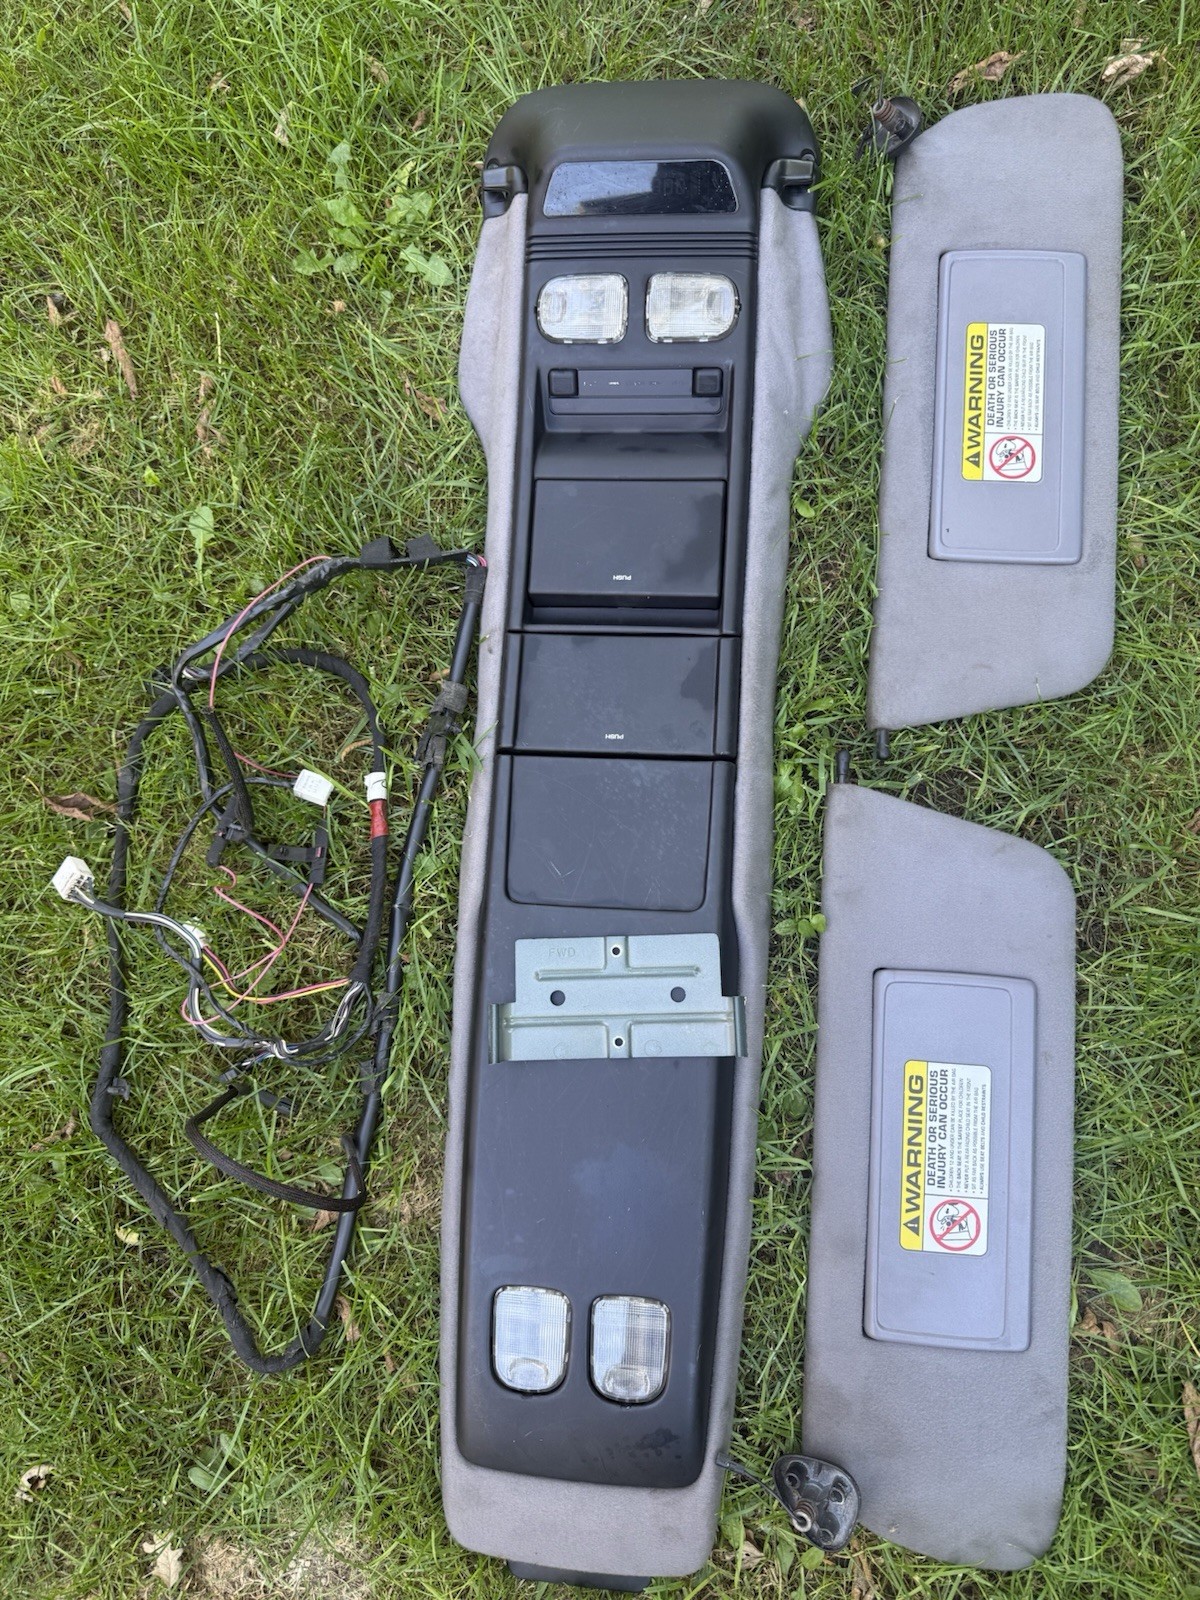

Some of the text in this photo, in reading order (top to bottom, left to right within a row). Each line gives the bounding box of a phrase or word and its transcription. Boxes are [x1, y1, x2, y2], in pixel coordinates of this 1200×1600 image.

[968, 335, 983, 450] WARNING
[987, 330, 997, 426] DEATH OR SERIOUS
[998, 328, 1006, 362] OCCUR
[996, 390, 1004, 428] INJURY
[548, 947, 576, 958] FWD
[905, 1074, 923, 1213] WARNING
[927, 1070, 938, 1186] DEATH OR SERIOUS
[937, 1069, 948, 1188] INJURY CAN OCCUR
